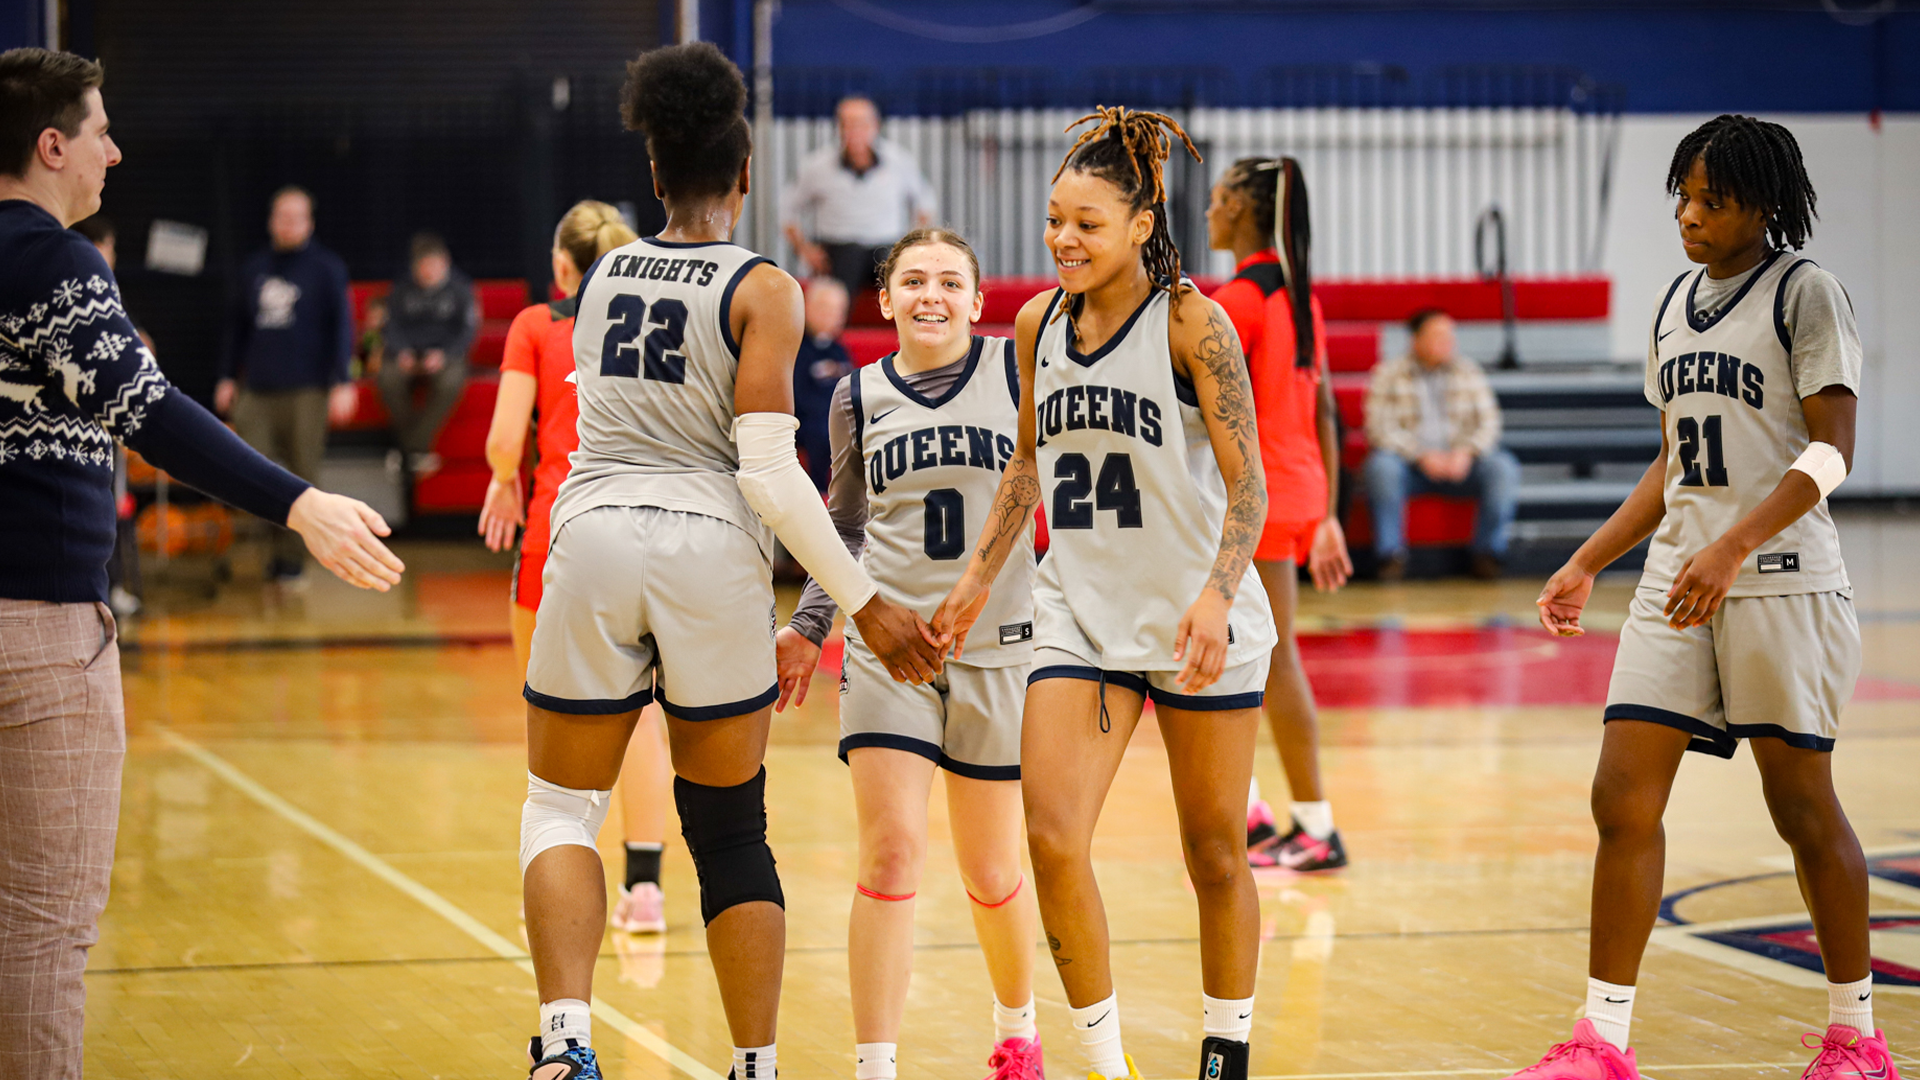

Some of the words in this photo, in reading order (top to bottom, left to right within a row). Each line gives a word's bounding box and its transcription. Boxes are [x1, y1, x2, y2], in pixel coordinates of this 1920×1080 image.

[607, 254, 719, 287] KNIGHTS
[600, 293, 688, 385] 22
[1657, 351, 1764, 410] UEENS
[869, 425, 1015, 495] QUEENS
[1676, 414, 1729, 487] 21
[923, 488, 966, 561] 0
[1051, 452, 1143, 529] 24
[1786, 558, 1794, 566] M
[1024, 627, 1030, 636] S
